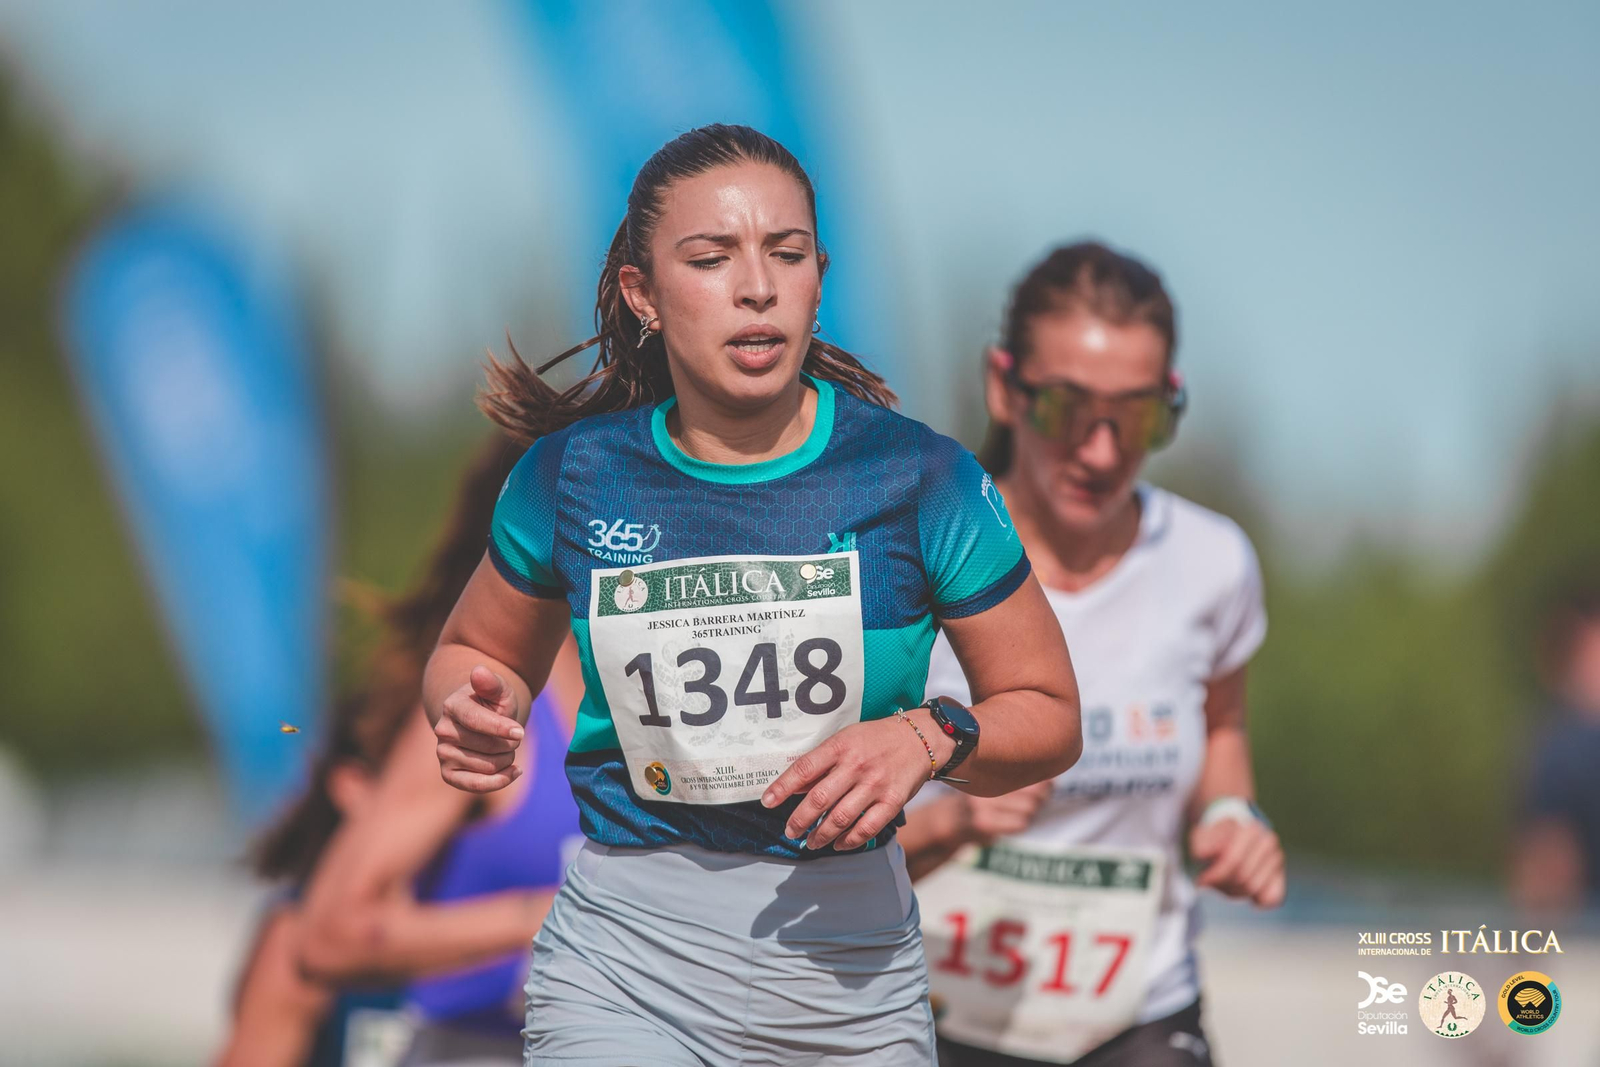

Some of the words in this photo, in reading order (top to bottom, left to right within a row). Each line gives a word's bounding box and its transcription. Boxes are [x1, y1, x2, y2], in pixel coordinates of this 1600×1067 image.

[588, 519, 643, 552] 365
[587, 547, 653, 564] TRAINING
[664, 567, 786, 601] ITÁLICA
[807, 588, 836, 597] Sevilla
[726, 596, 749, 604] CROSS
[647, 618, 690, 630] JESSICA
[693, 614, 744, 628] BARRERA
[747, 608, 806, 622] MARTÍNEZ
[692, 624, 762, 639] 365TRAINING
[624, 637, 847, 728] 1348
[680, 776, 697, 784] CROSS
[697, 773, 744, 783] INTERNACIONAL
[709, 780, 744, 790] NOVIEMBRE
[746, 779, 754, 787] DE
[756, 777, 769, 786] 2025
[934, 909, 1134, 998] 1517
